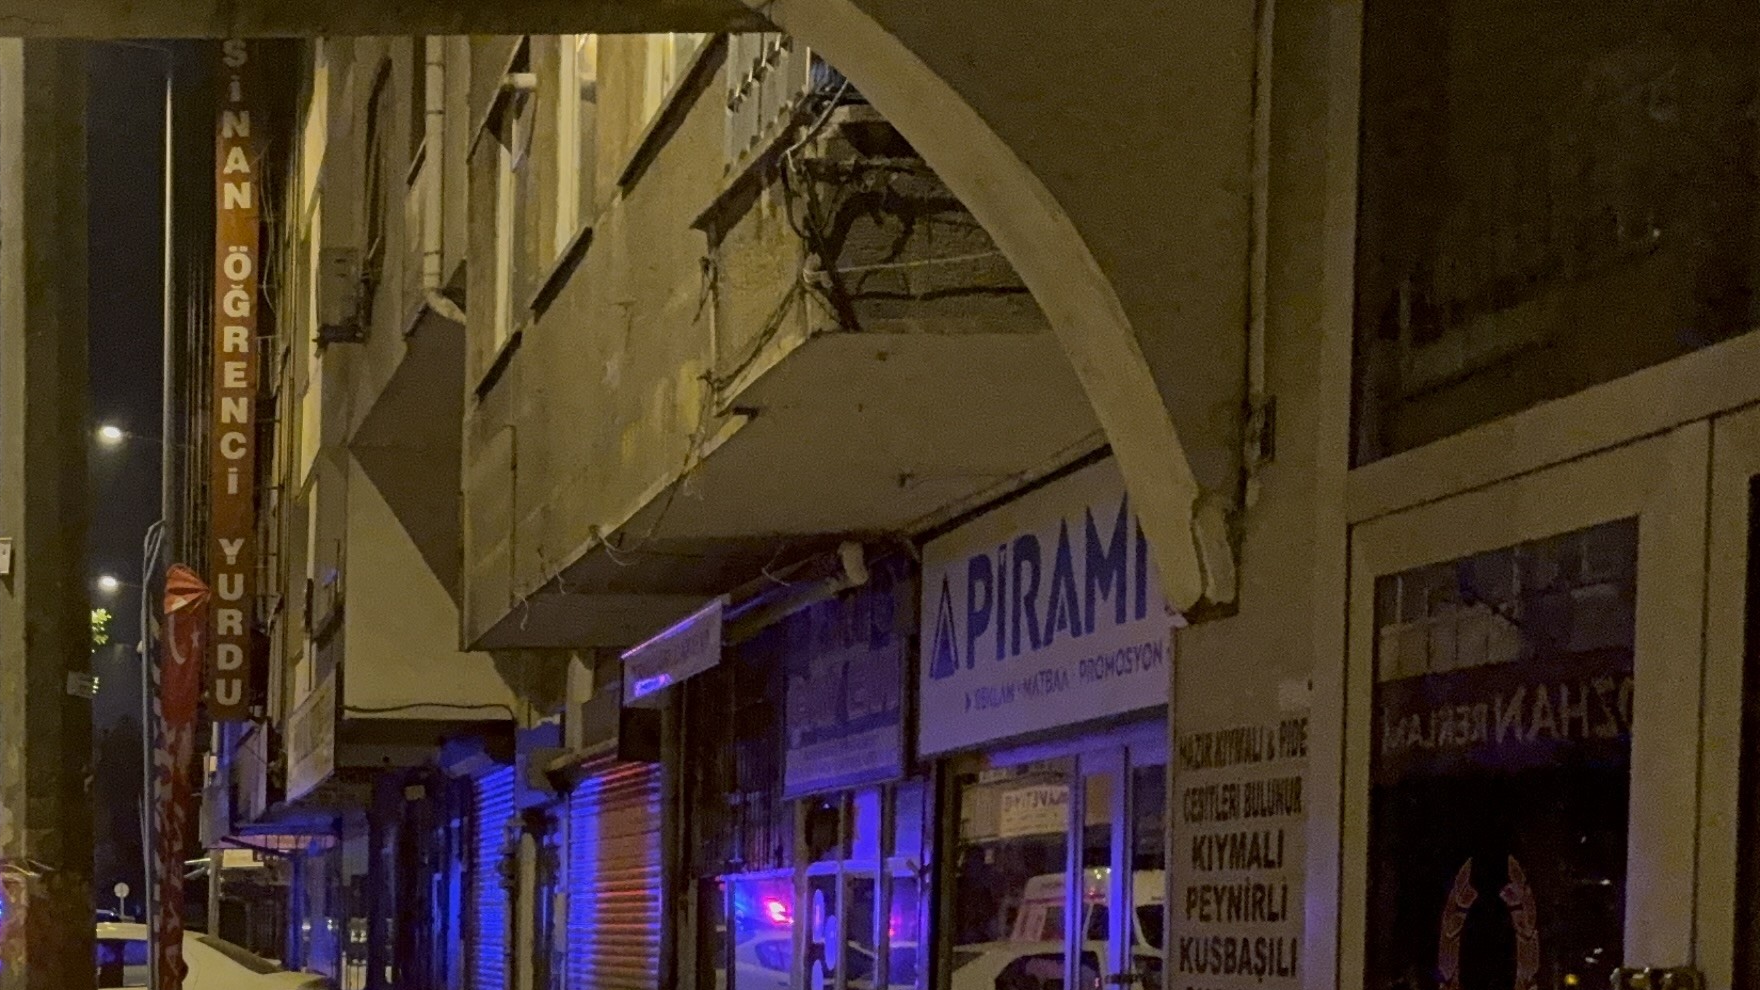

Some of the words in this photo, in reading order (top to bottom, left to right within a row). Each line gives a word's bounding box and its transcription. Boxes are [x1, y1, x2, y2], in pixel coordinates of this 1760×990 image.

[220, 246, 252, 494] ÖĞRENCİ
[216, 538, 244, 706] YURDU
[1079, 640, 1164, 684] PROMOSYON
[1192, 829, 1284, 872] KIYMALI
[1185, 877, 1288, 923] PEYNİRLİ
